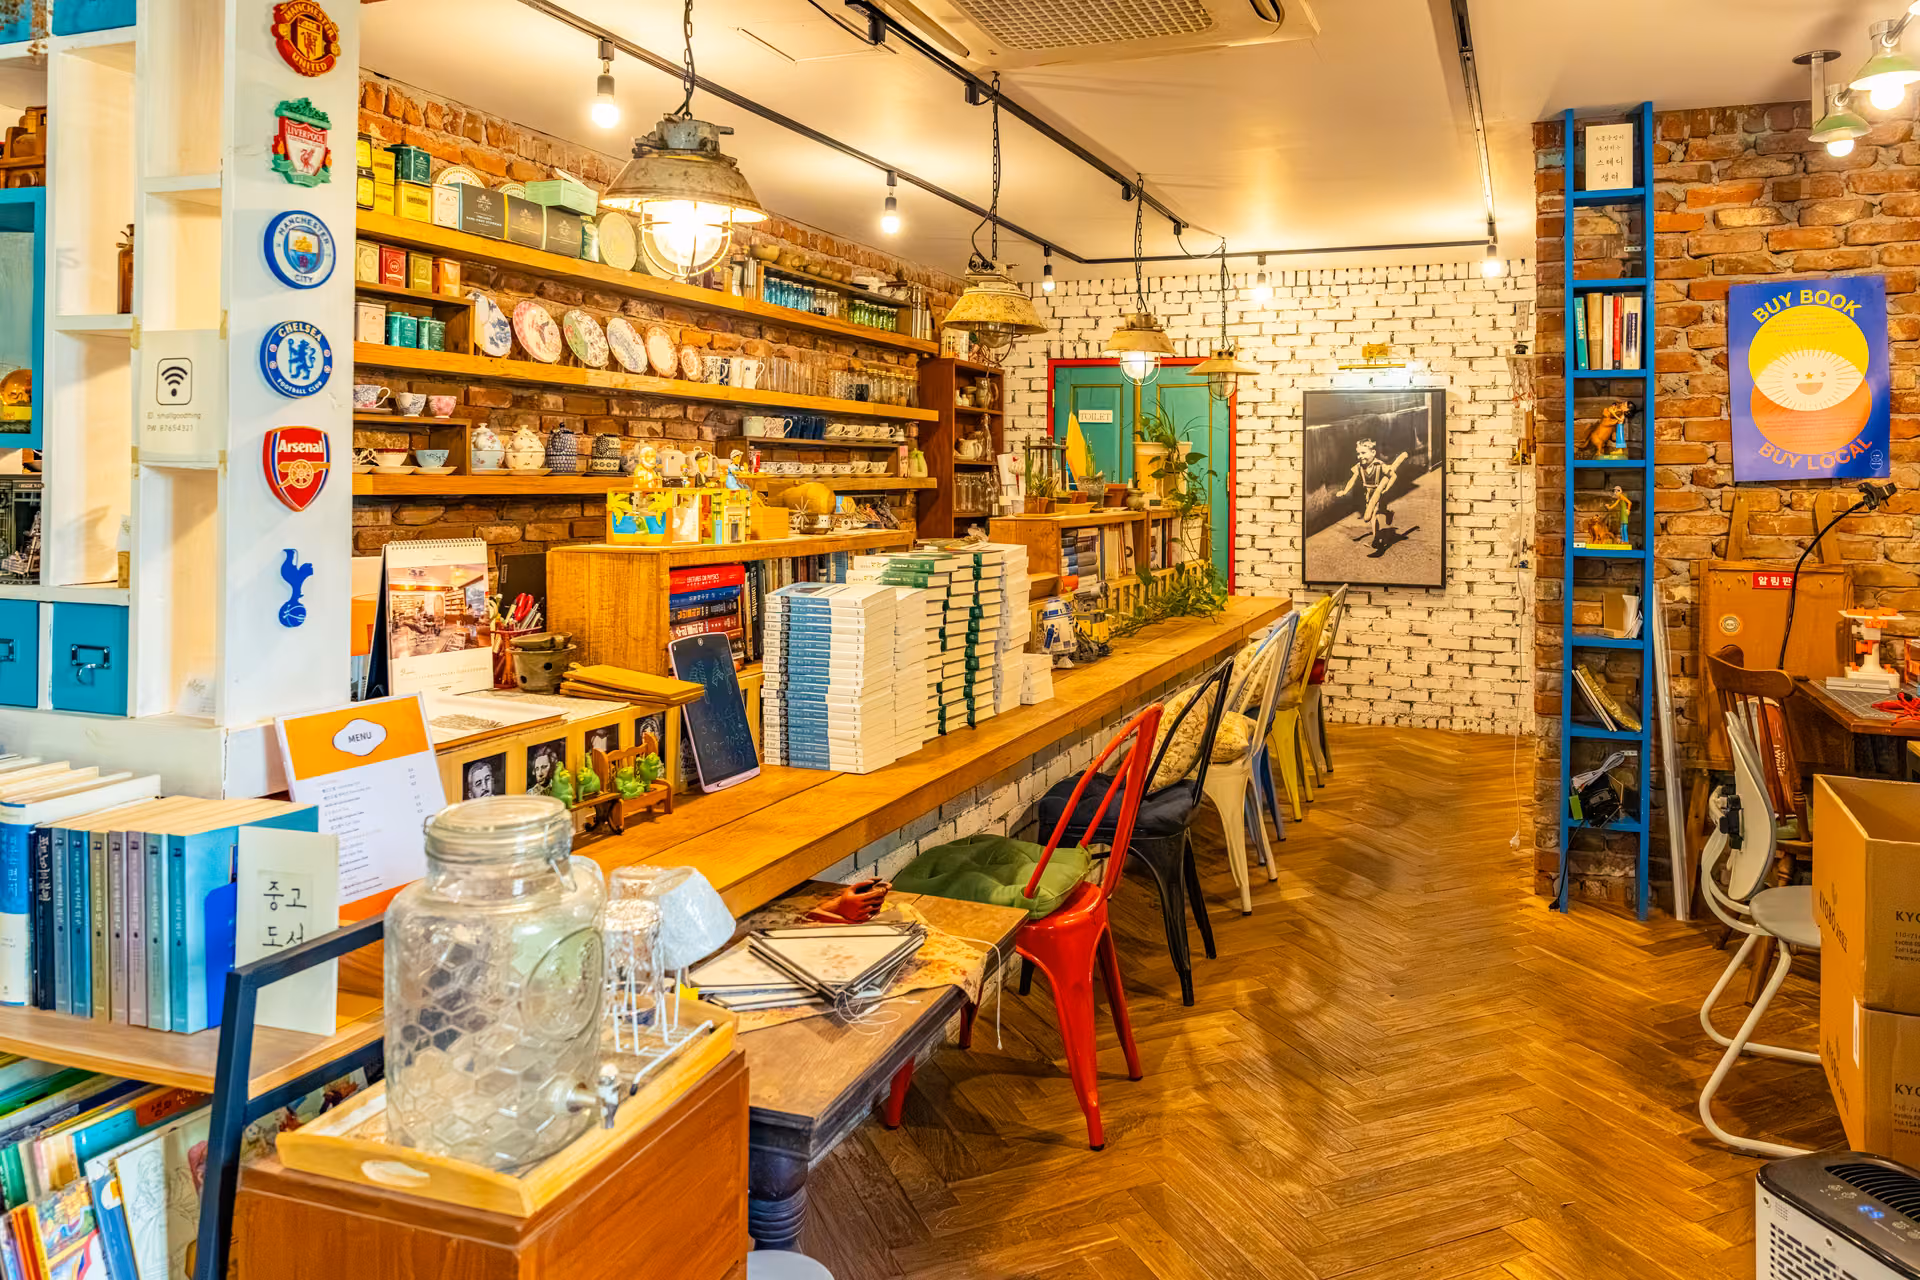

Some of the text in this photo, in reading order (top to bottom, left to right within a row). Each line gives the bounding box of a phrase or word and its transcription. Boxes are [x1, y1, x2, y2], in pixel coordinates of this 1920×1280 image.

[284, 3, 335, 38] MANCHESTER
[291, 52, 327, 72] UNITED
[287, 125, 325, 144] LIVERPOOL
[1596, 156, 1623, 166] 스테디
[278, 216, 330, 246] MANCHESTER
[294, 274, 313, 284] CITY
[1752, 289, 1862, 323] BUY BOOK
[278, 322, 322, 342] CHELSEA
[277, 378, 323, 394] FOOTBALL CLUB
[1079, 412, 1112, 421] TOILET
[278, 439, 323, 453] Arsenal
[1758, 441, 1802, 469] BUY
[1807, 438, 1872, 470] LOCAL
[1758, 576, 1793, 587] 알림판
[348, 731, 372, 744] MENU
[263, 881, 307, 911] 중고
[1819, 890, 1836, 932] KYOBO
[262, 922, 304, 948] 도서
